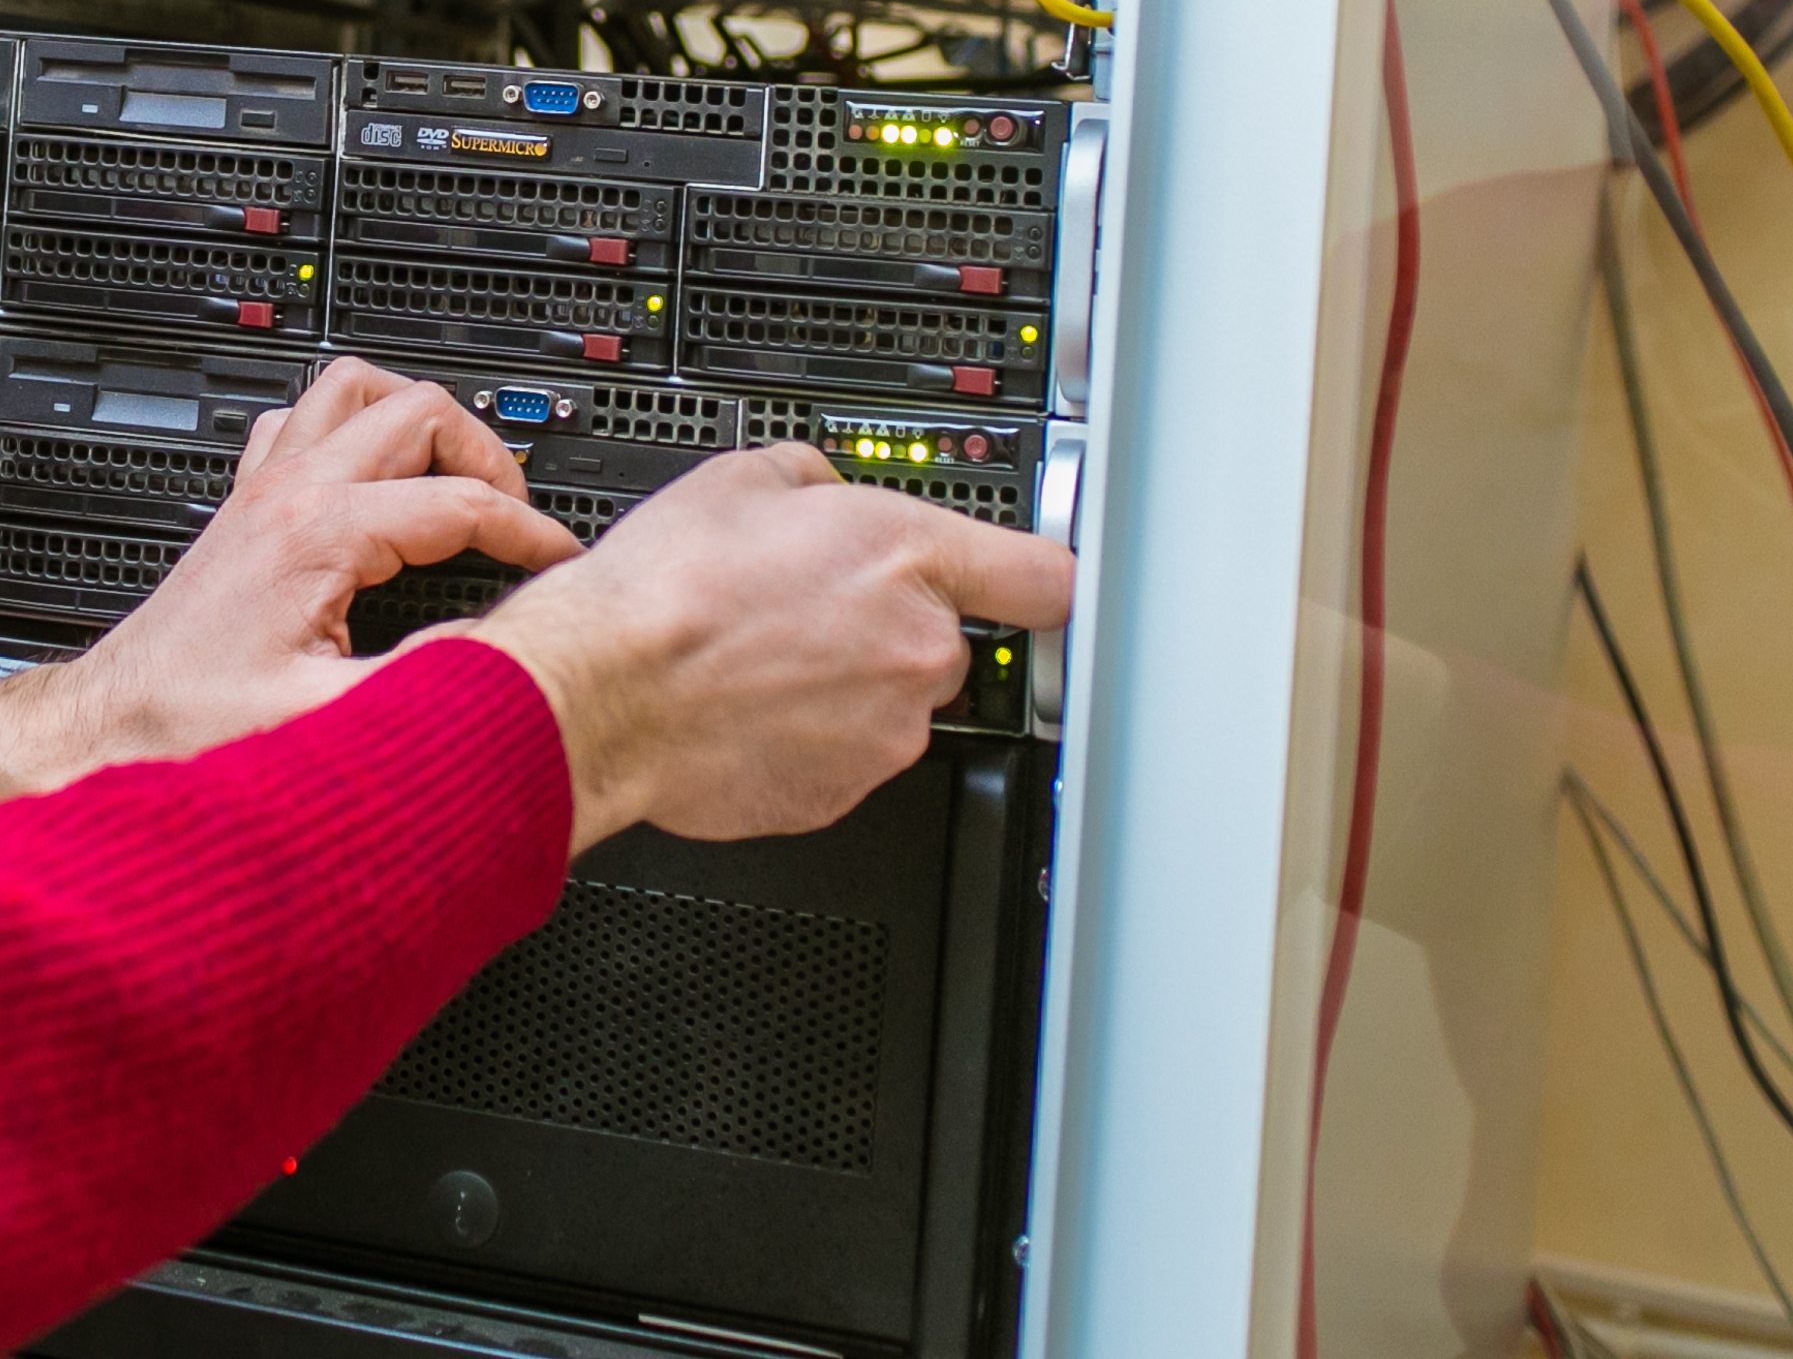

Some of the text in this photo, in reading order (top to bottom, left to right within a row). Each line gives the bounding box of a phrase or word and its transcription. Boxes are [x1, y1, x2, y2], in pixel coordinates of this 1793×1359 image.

[361, 123, 403, 148] disc
[417, 127, 450, 139] DVD
[451, 133, 548, 157] SUPERMICRO
[960, 140, 980, 148] RESET
